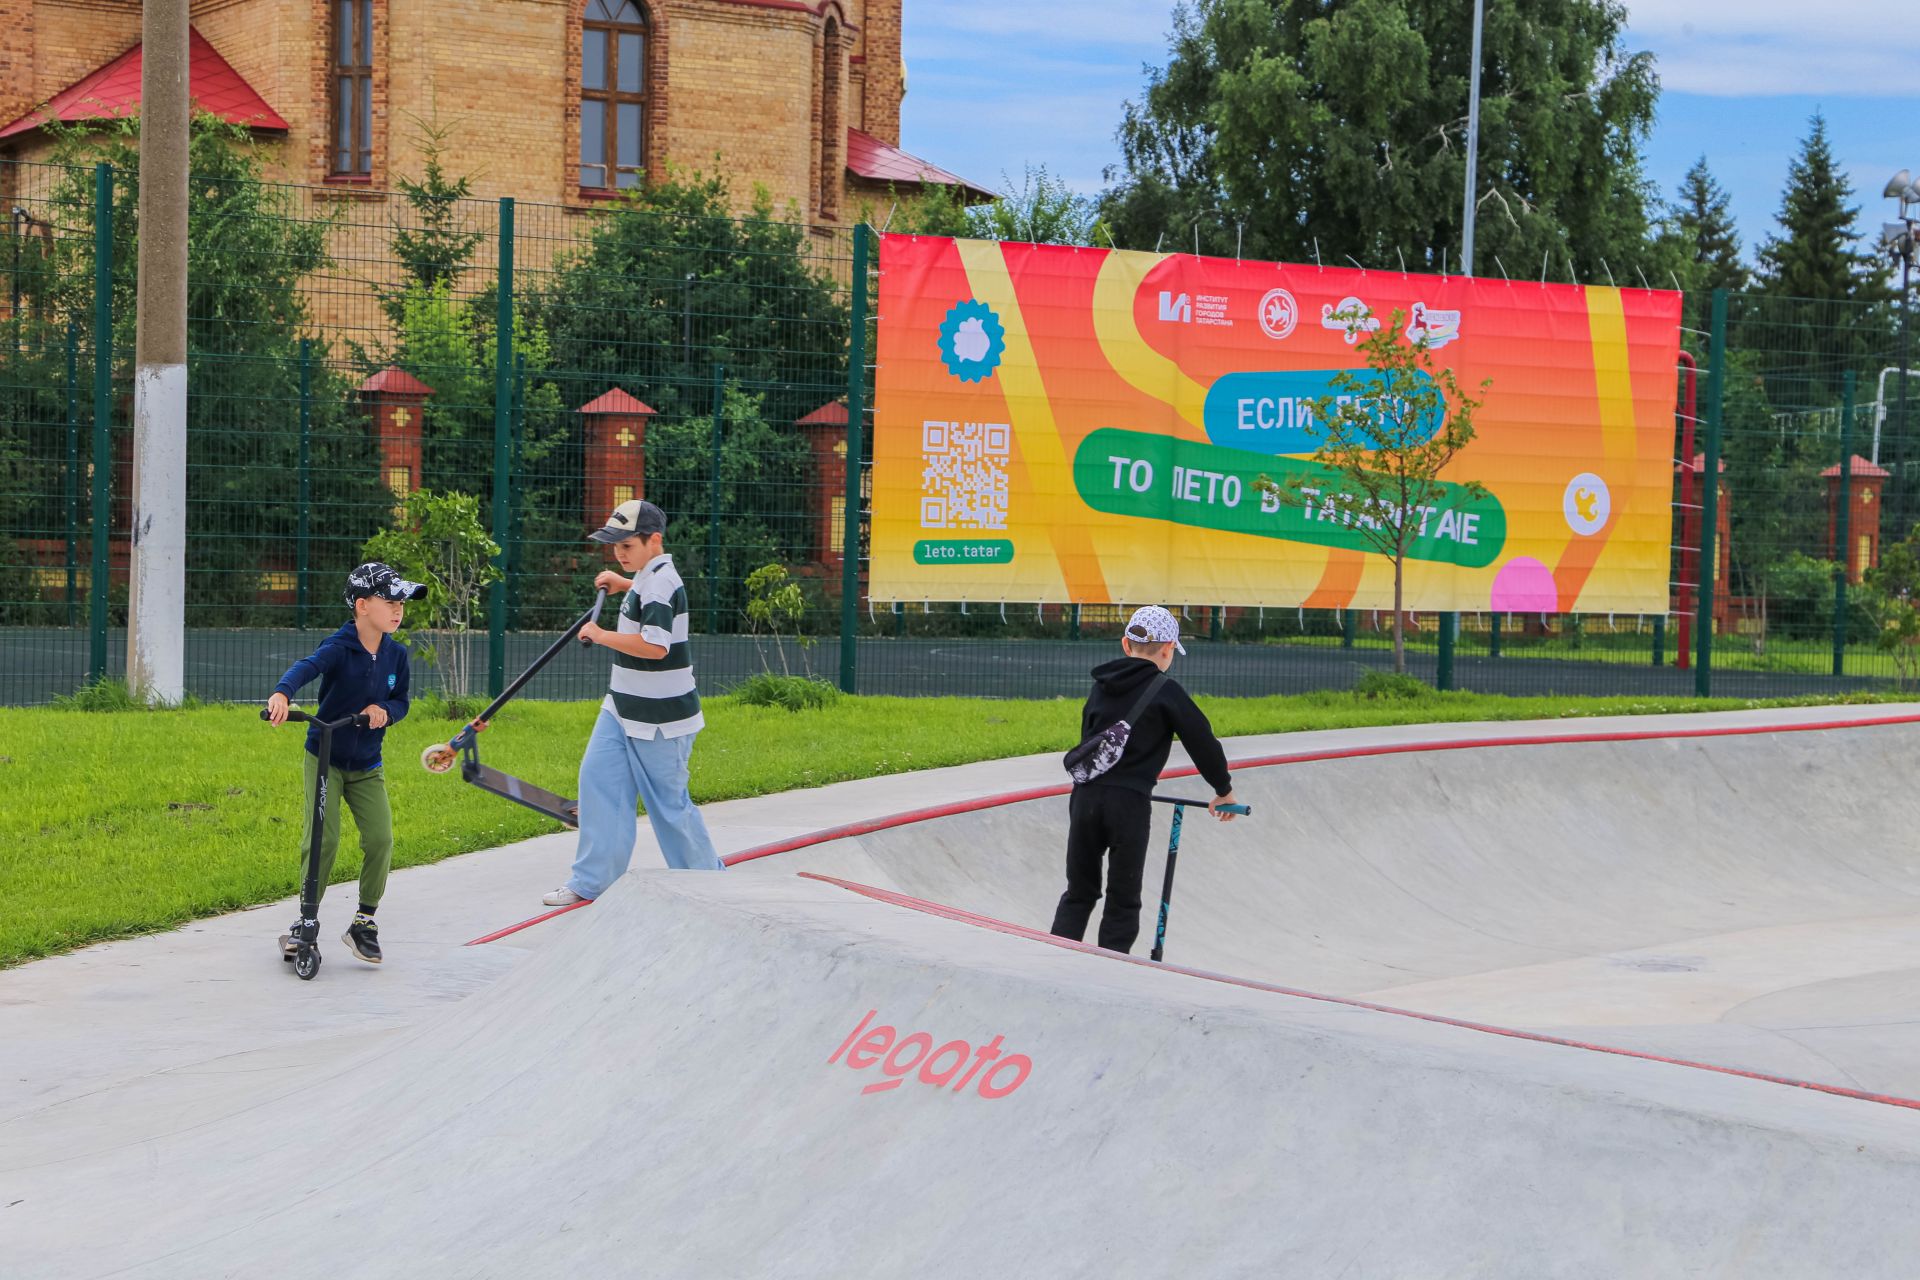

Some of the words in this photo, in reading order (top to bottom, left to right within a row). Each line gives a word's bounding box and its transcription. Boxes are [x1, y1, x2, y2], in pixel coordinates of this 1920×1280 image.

[1196, 294, 1229, 303] ИНСТИТУТ
[1196, 302, 1228, 311] РАЗВИТИЯ
[1195, 310, 1225, 318] ГОРОДОВ
[1195, 317, 1233, 326] ТАТАРСТАНА
[1237, 396, 1313, 430] ЕСЛИ
[1108, 456, 1153, 493] ТО
[1261, 481, 1281, 513] В
[924, 544, 1001, 558] leto.tatar
[827, 1009, 1033, 1099] legato
